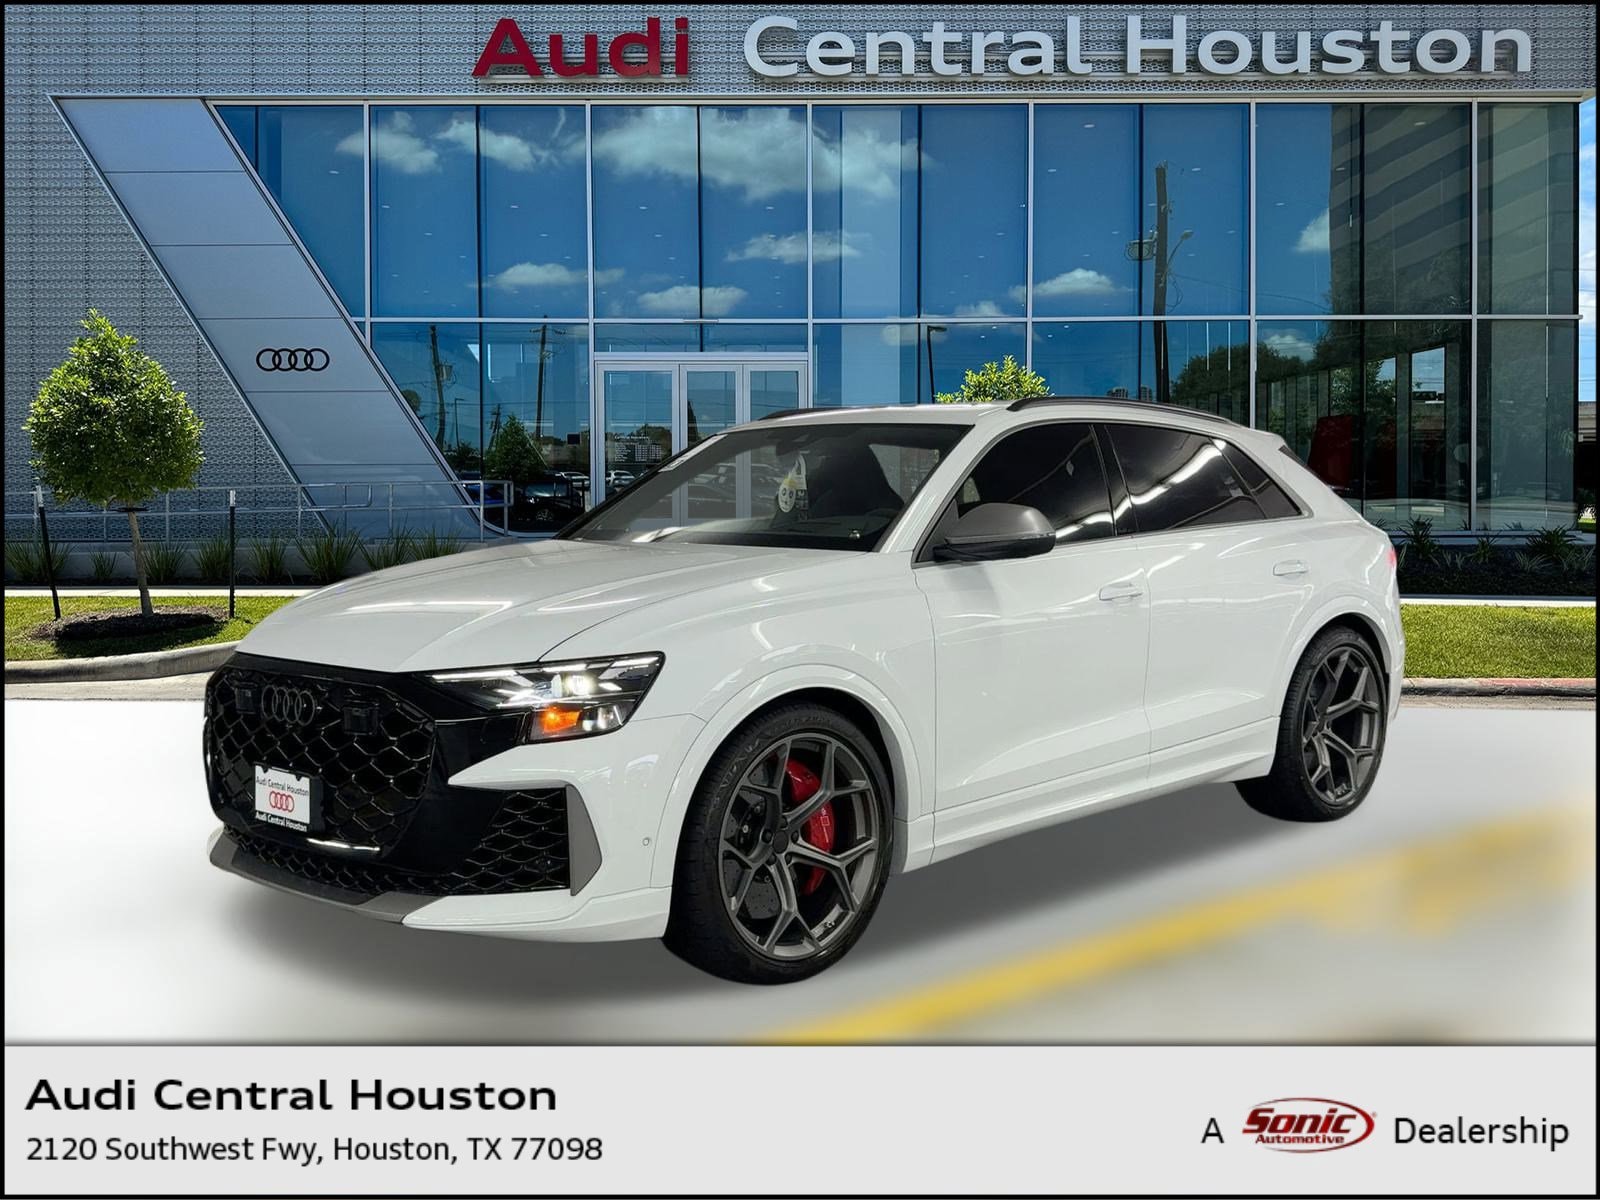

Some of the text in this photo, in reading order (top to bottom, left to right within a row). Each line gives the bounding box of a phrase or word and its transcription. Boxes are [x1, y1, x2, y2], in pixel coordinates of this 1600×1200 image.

[472, 14, 1532, 79] Audi Central Houston
[256, 775, 309, 797] Audi Central Houston
[255, 811, 308, 833] Audi Central Houston
